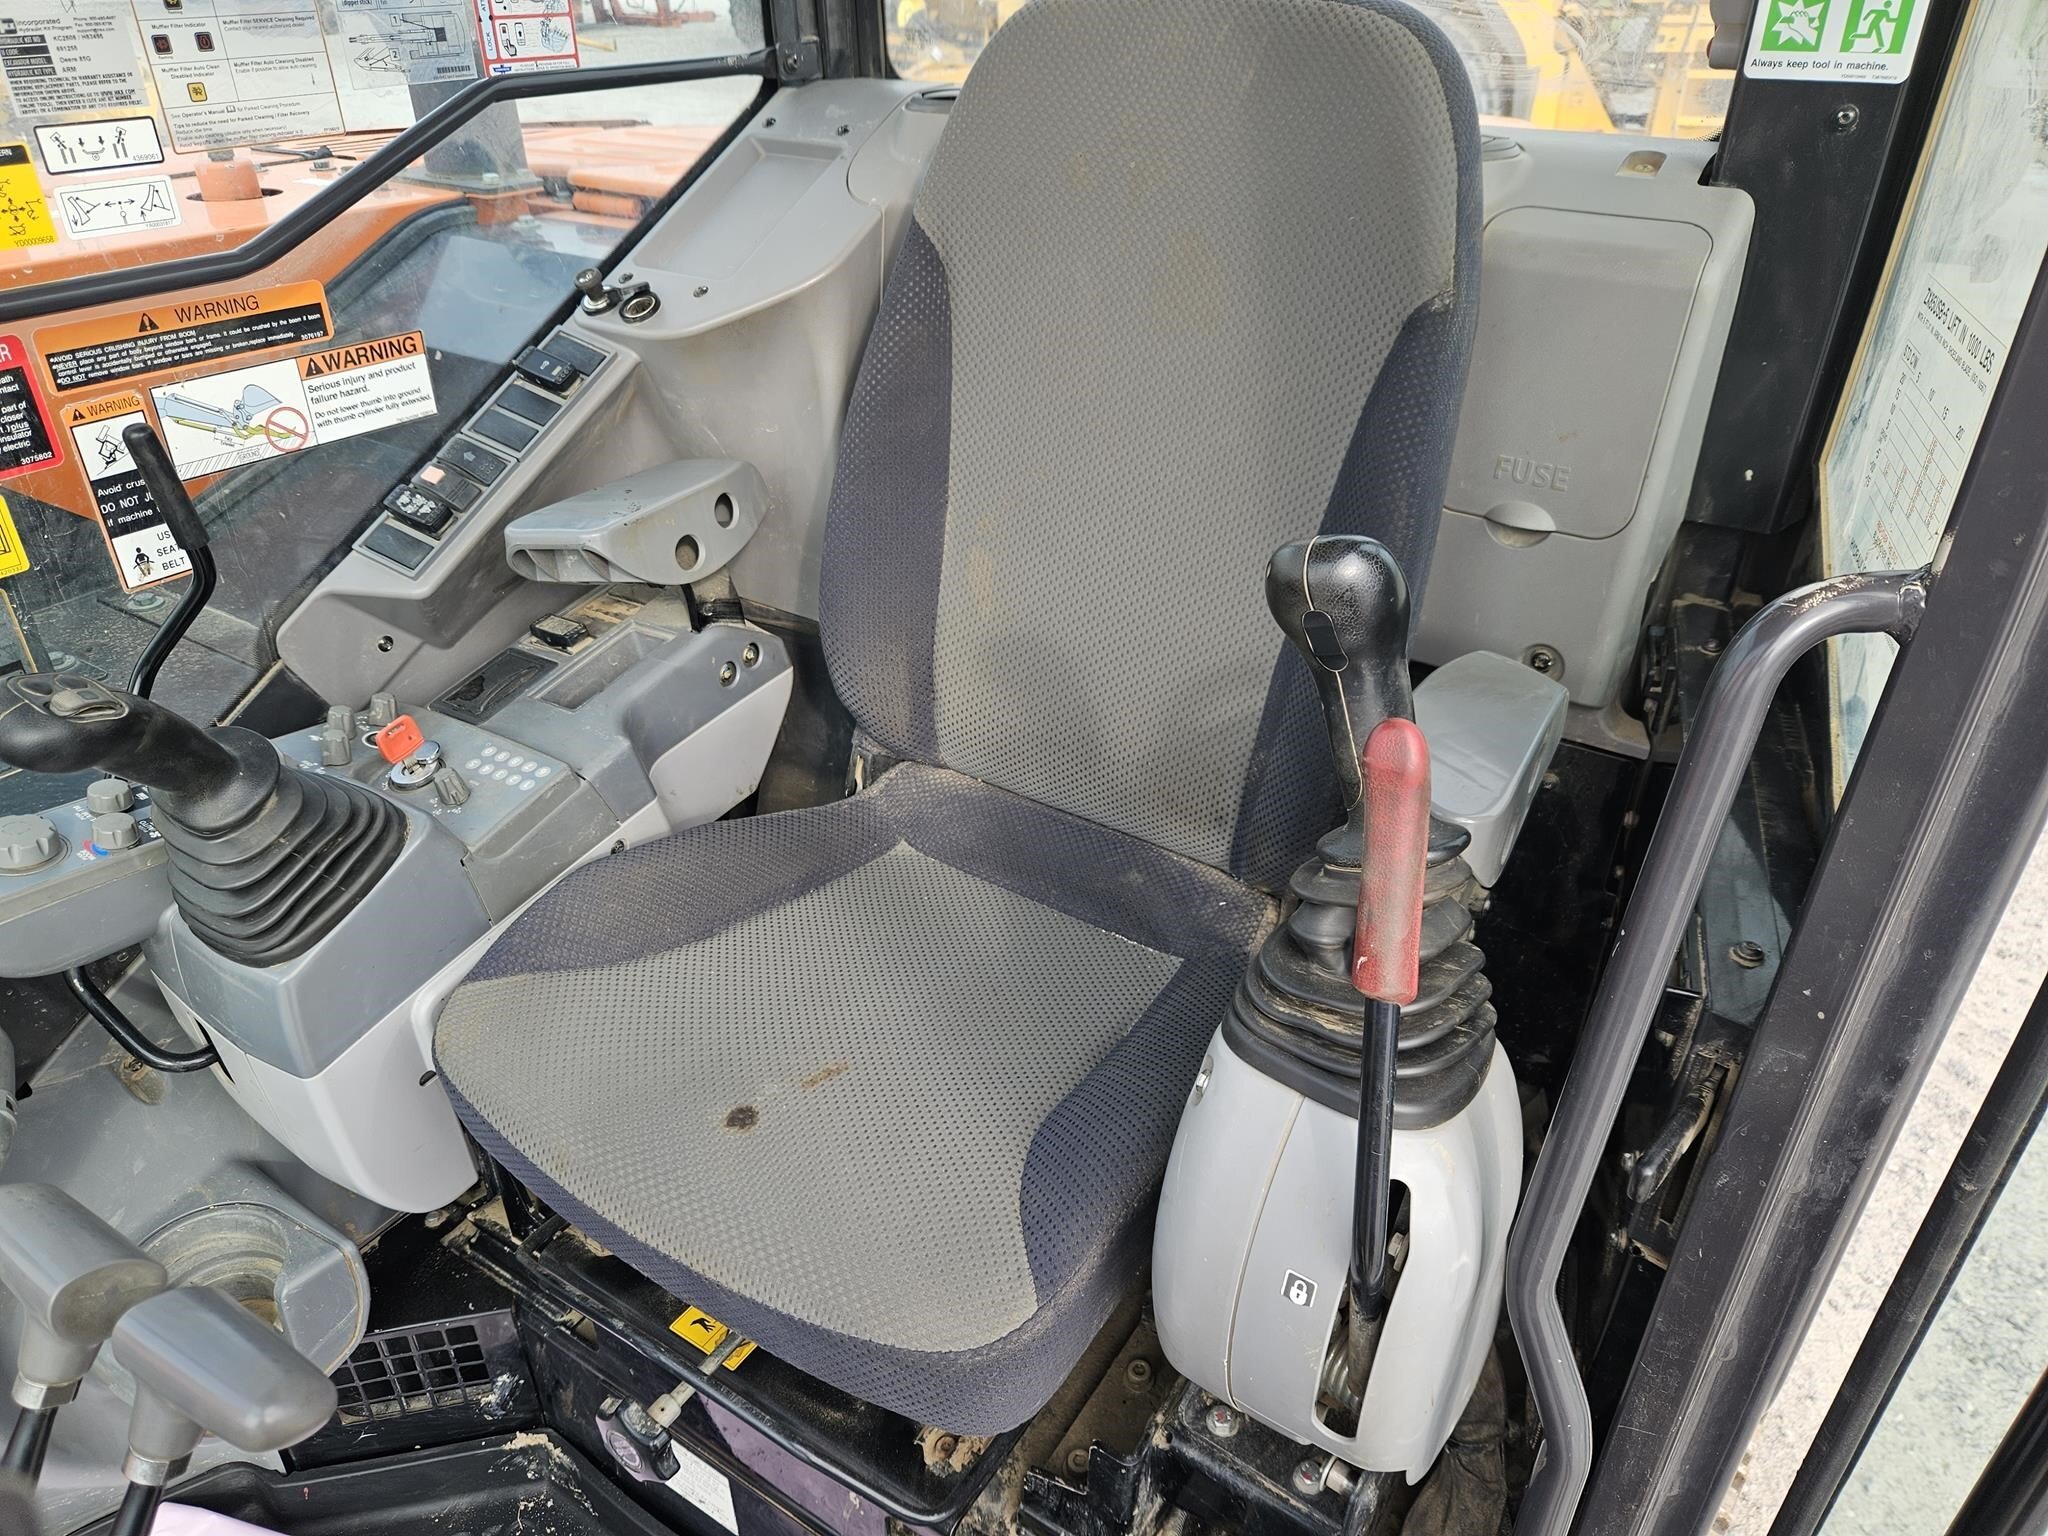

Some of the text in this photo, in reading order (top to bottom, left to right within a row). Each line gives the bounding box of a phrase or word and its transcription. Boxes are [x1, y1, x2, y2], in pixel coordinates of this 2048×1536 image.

[1750, 59, 1784, 69] Always
[1786, 61, 1809, 69] keep
[1812, 61, 1831, 69] tool
[1846, 62, 1890, 70] machine.
[14, 236, 54, 247] YD00009658
[175, 294, 260, 323] WARNING
[56, 361, 78, 370] NEVER
[129, 347, 143, 356] body
[144, 343, 164, 353] beyond
[252, 322, 270, 331] crushed
[289, 316, 302, 324] boom
[1947, 311, 1962, 336] LIFT
[1959, 324, 1968, 345] IN
[1966, 332, 1982, 359] 1000
[0, 344, 12, 363] R
[55, 329, 195, 363] AVOID SERIOUS CRUSHING INJURY FROM BOOM
[322, 336, 417, 372] WARNING
[58, 369, 78, 377] control
[102, 357, 132, 368] accidentally
[134, 352, 155, 362] bumped
[165, 346, 188, 355] otherwise
[110, 365, 129, 373] window
[154, 357, 171, 365] window
[206, 346, 224, 355] missing
[0, 375, 14, 384] ath
[308, 362, 416, 393] Serious injury and product
[311, 385, 370, 404] failure hazard.
[340, 403, 358, 412] lower
[360, 397, 382, 407] thumb
[398, 388, 421, 399] ground
[1, 400, 27, 414] part of
[87, 396, 140, 416] WARNING
[317, 419, 332, 427] with
[334, 413, 356, 423] thumb
[357, 406, 385, 419] cylinder
[386, 403, 399, 411] fully
[1, 412, 24, 423] closer
[11, 422, 29, 432] plus
[3, 440, 31, 452] electric
[20, 452, 52, 464] 3075802
[1494, 454, 1572, 492] FUSE
[97, 479, 145, 497] Avoid crus
[100, 493, 154, 514] DO NOT JU
[117, 509, 153, 524] machine
[157, 531, 171, 541] US
[162, 557, 186, 571] BELT
